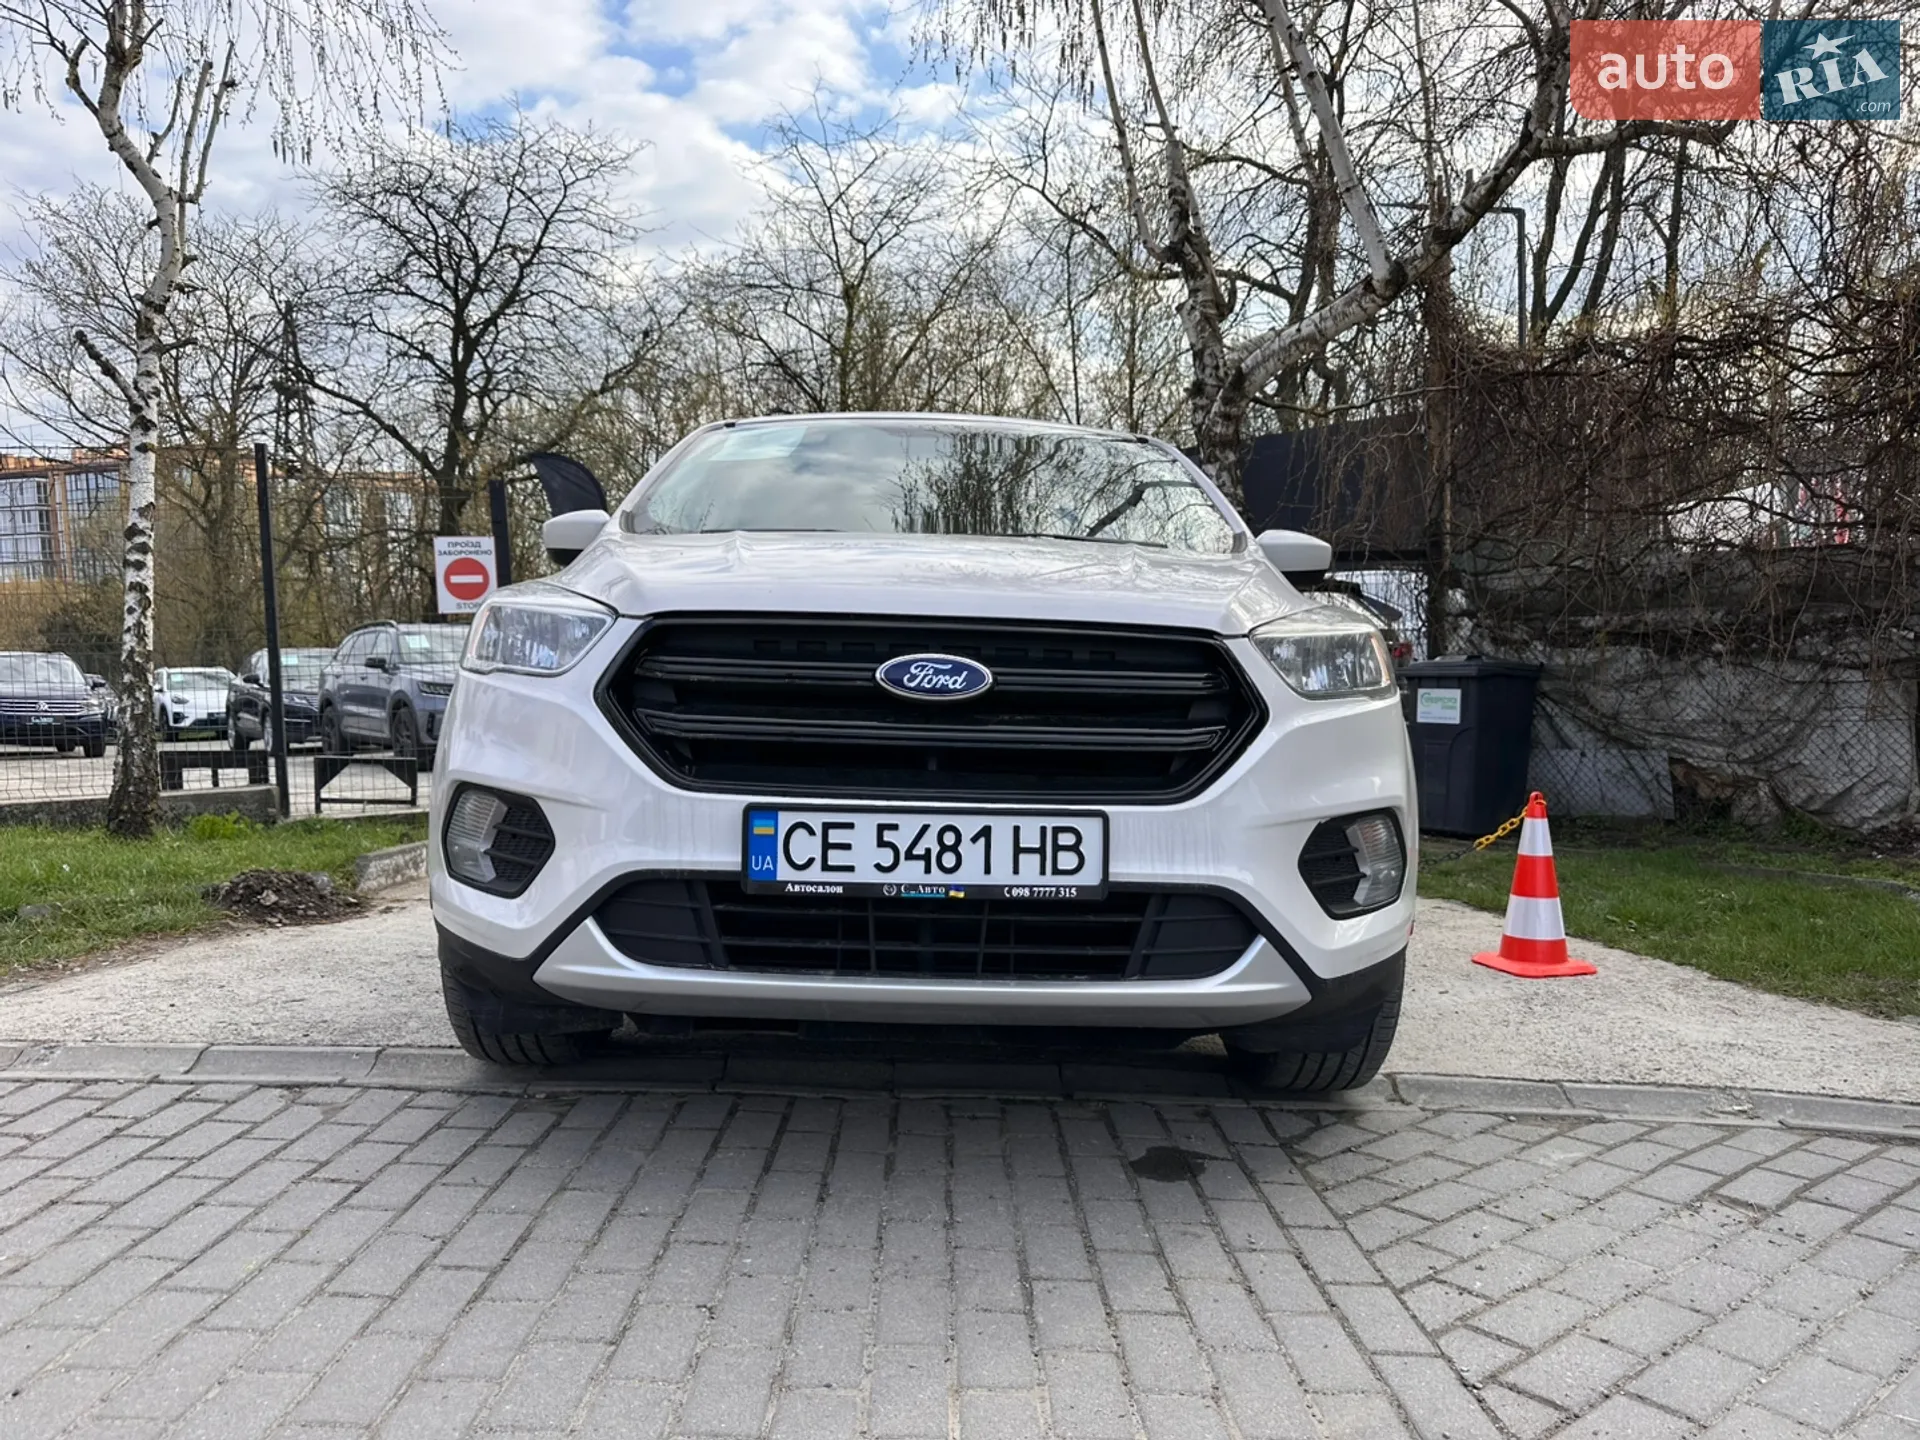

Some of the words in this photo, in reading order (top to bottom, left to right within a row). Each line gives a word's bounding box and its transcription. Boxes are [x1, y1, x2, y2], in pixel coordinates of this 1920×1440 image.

[438, 549, 493, 557] ЗАБОРОНЕНО
[903, 661, 968, 689] Ford
[782, 820, 856, 872] CE
[873, 822, 993, 875] 5481
[1012, 824, 1086, 877] HB
[751, 855, 774, 871] UA
[784, 882, 844, 894] Автосалон
[1011, 886, 1031, 898] 098
[1058, 886, 1078, 898] 315
